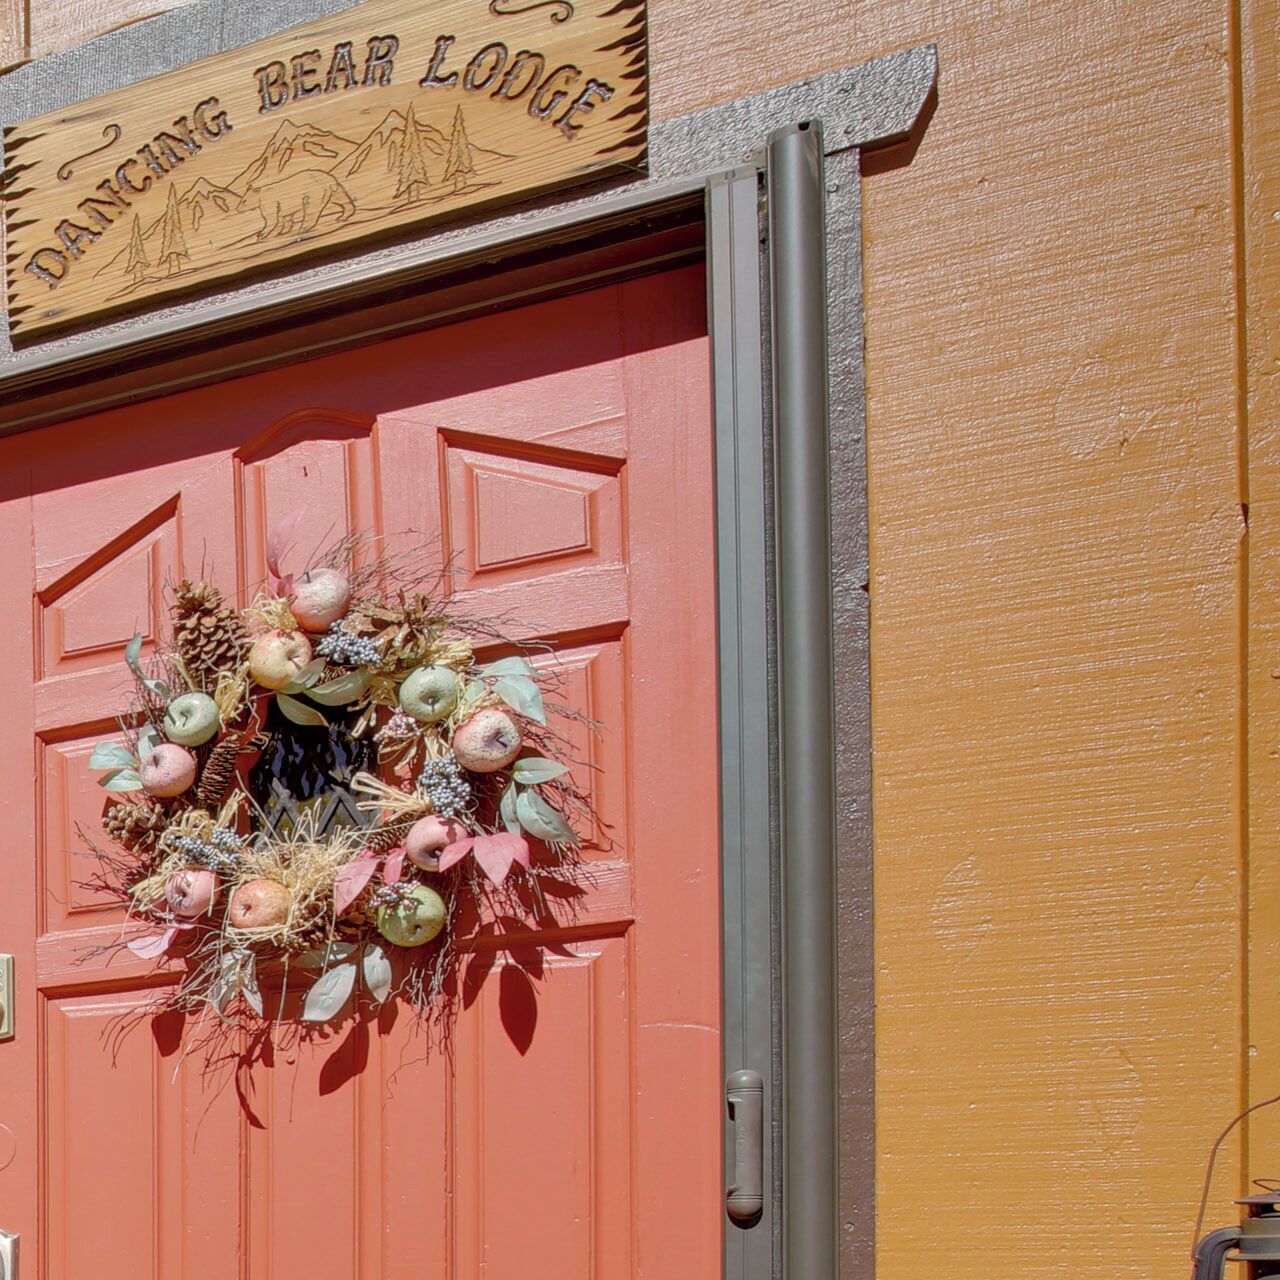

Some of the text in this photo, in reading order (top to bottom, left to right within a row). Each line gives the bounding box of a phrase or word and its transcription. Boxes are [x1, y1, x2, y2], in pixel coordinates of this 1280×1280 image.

[24, 33, 616, 289] DANCING BEAR LODGE
